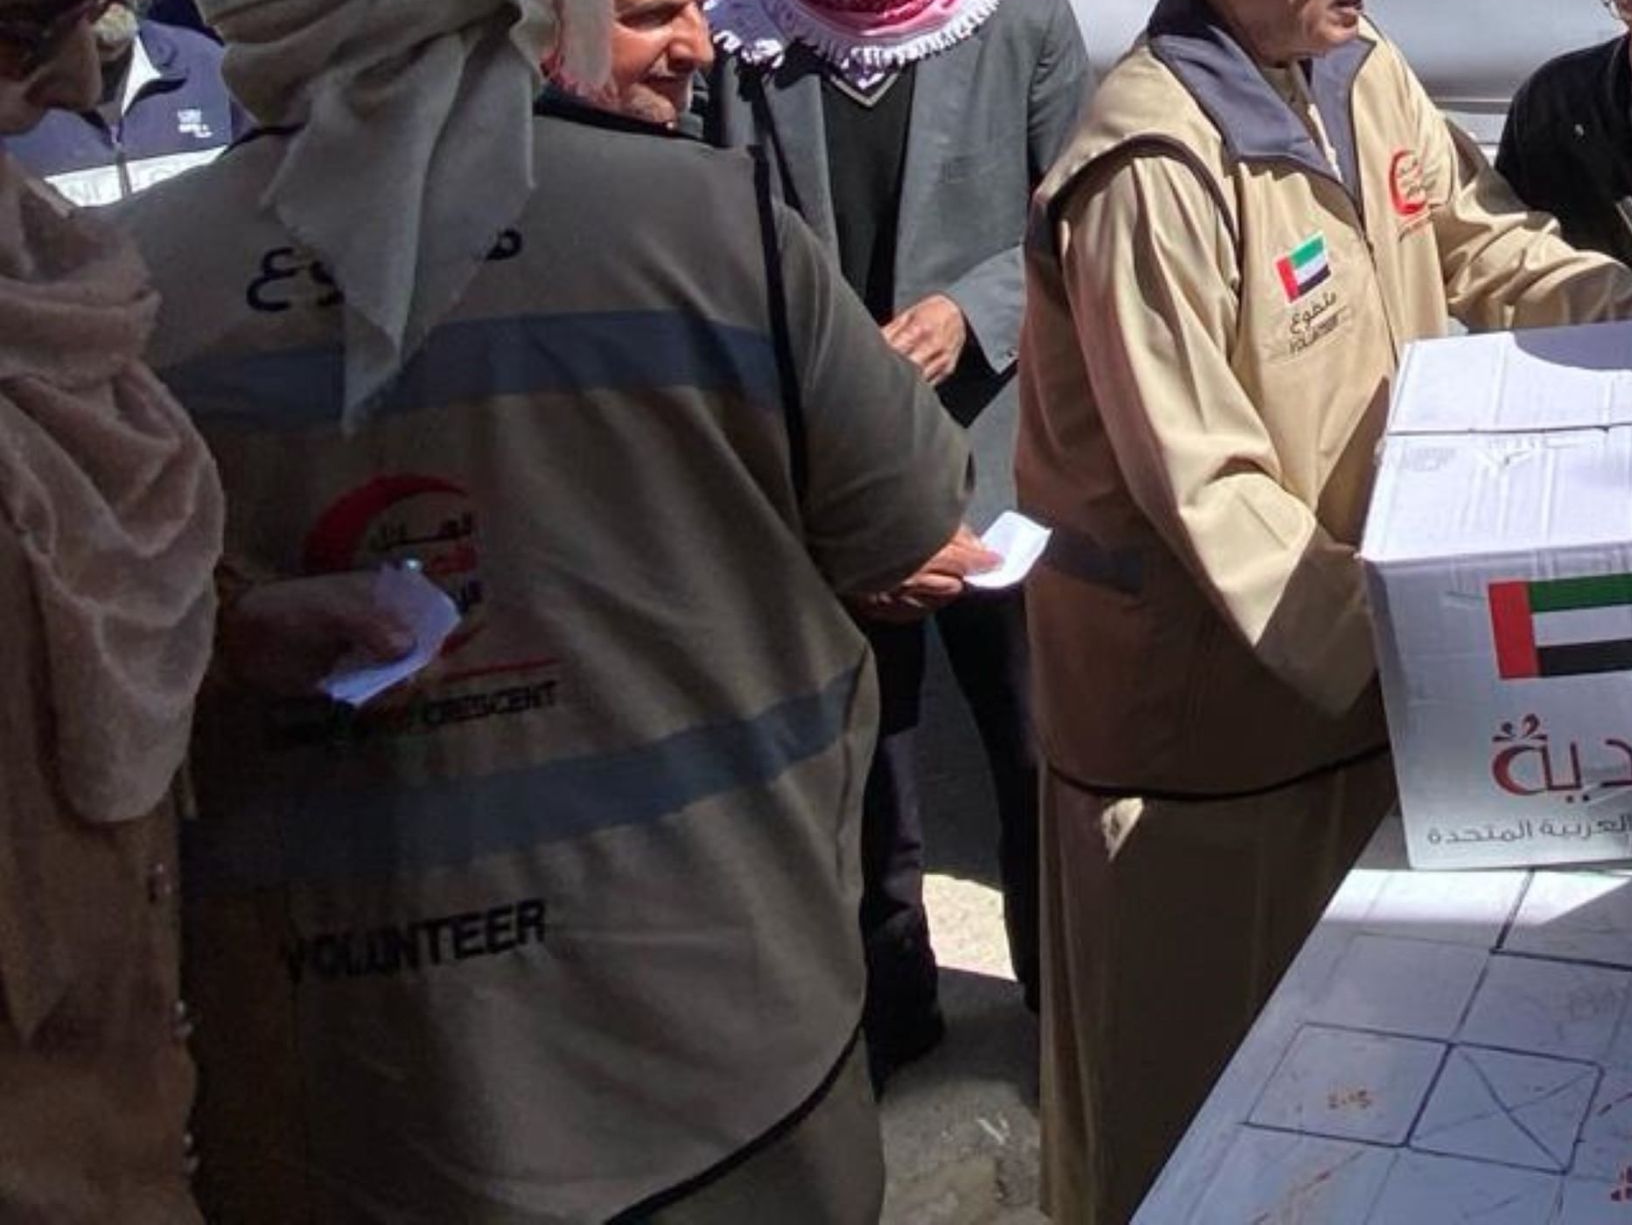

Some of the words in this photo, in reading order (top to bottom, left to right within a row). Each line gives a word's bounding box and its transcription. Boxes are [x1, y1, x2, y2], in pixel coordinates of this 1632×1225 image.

[246, 228, 523, 312] موع
[1427, 821, 1532, 844] المتحدة
[286, 897, 547, 985] VOLUNTEER
